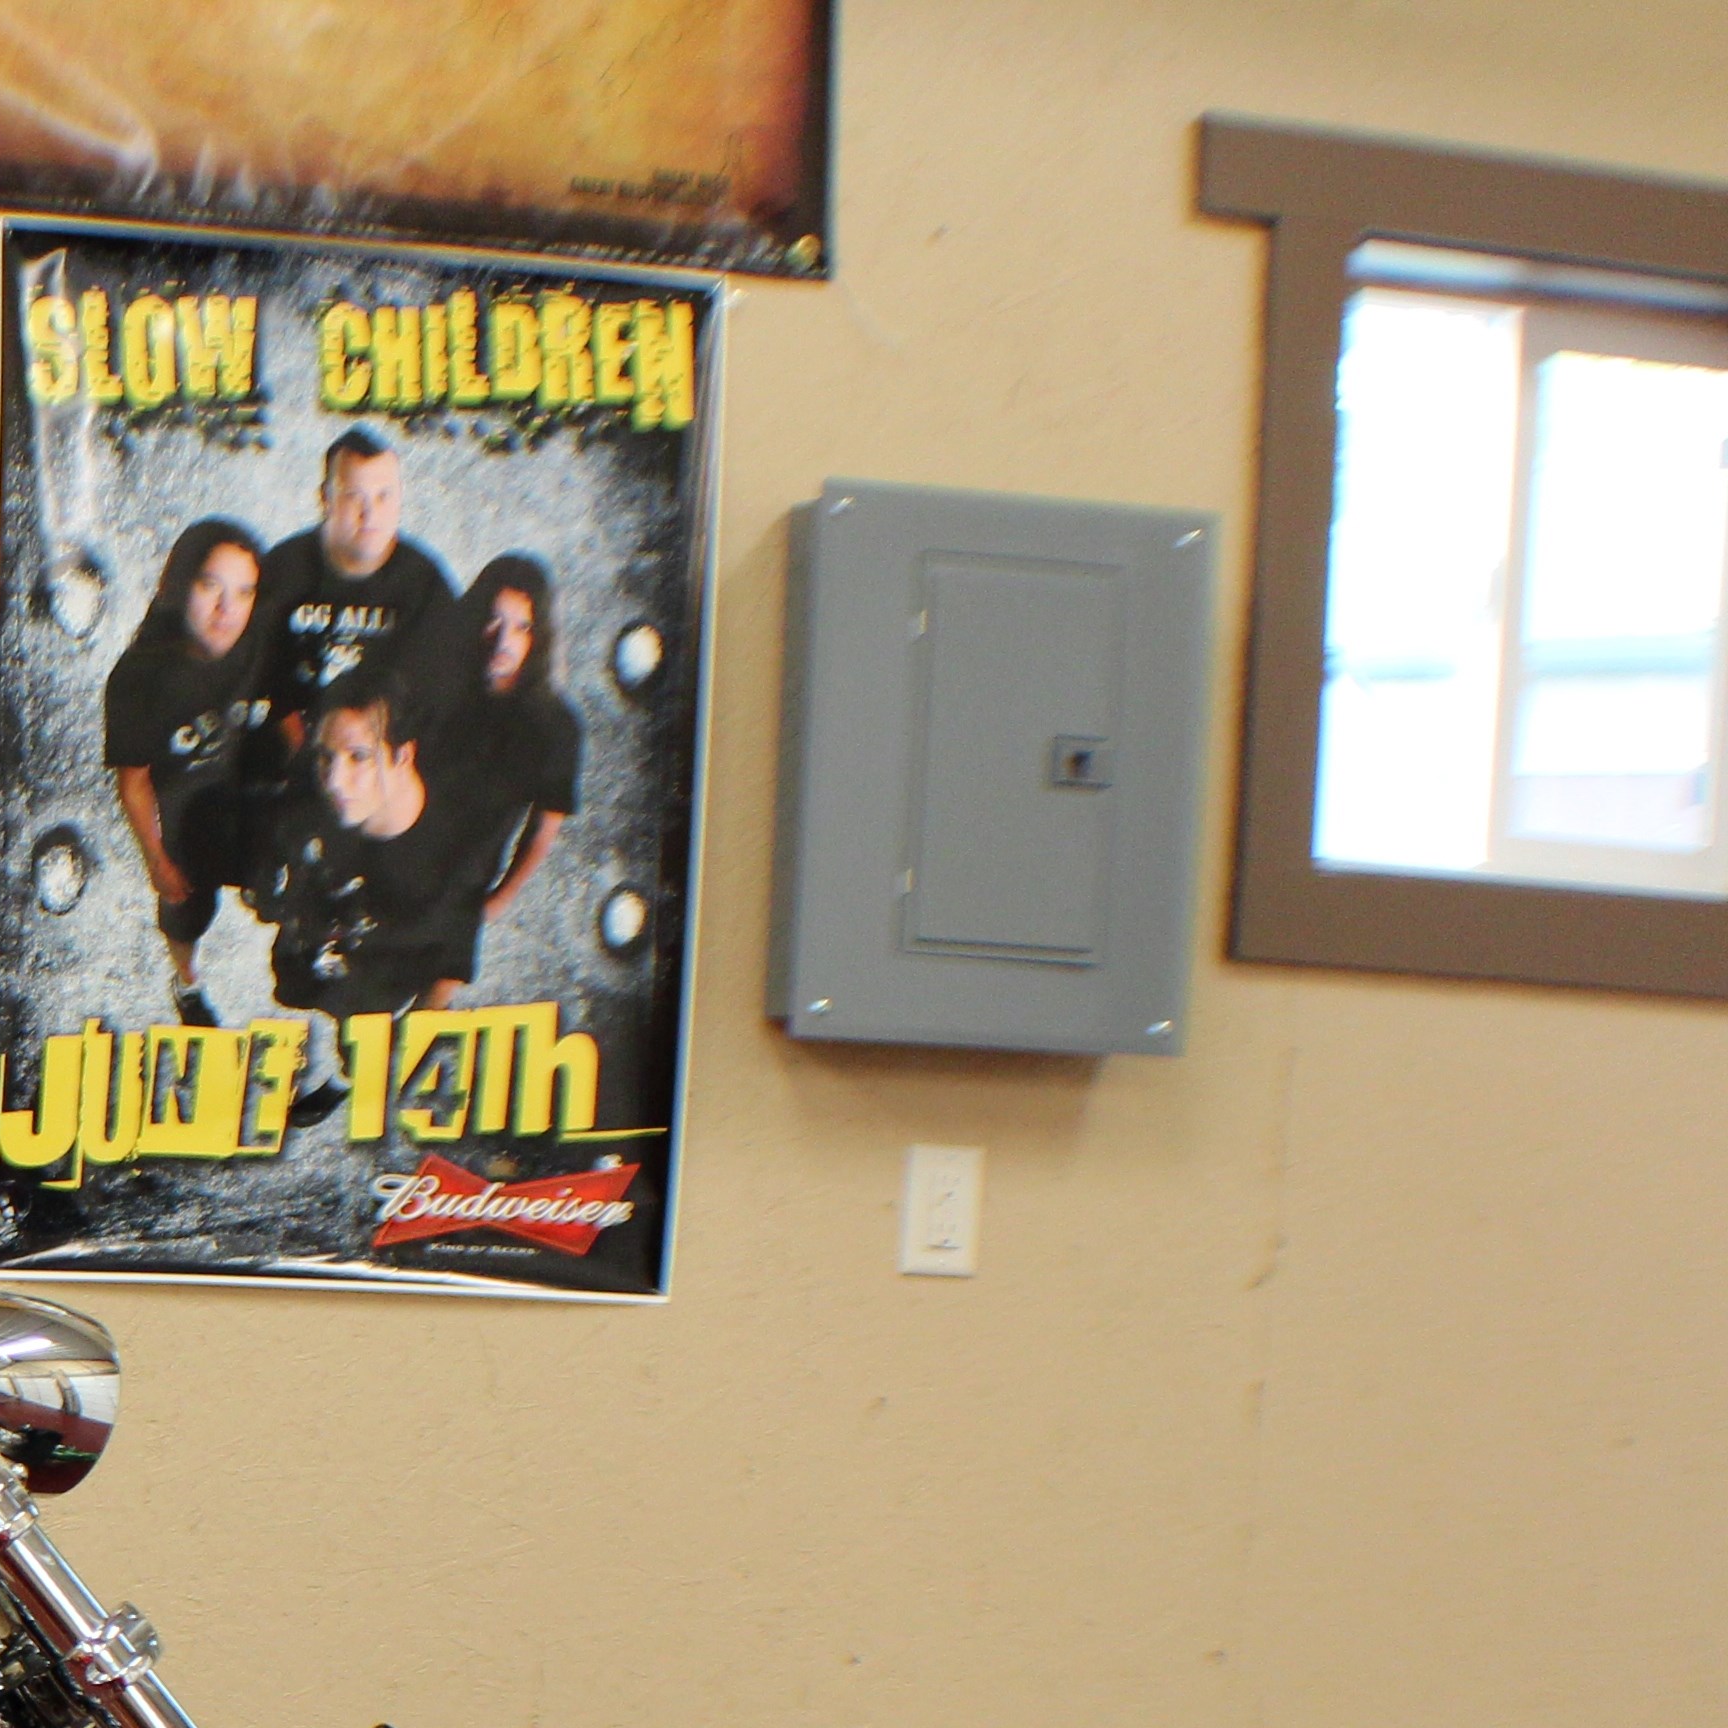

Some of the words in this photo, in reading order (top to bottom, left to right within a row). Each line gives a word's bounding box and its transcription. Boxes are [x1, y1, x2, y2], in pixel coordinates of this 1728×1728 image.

[27, 287, 257, 410] SLOW
[321, 287, 696, 431] CHILDREN
[372, 1173, 635, 1228] Budweiser
